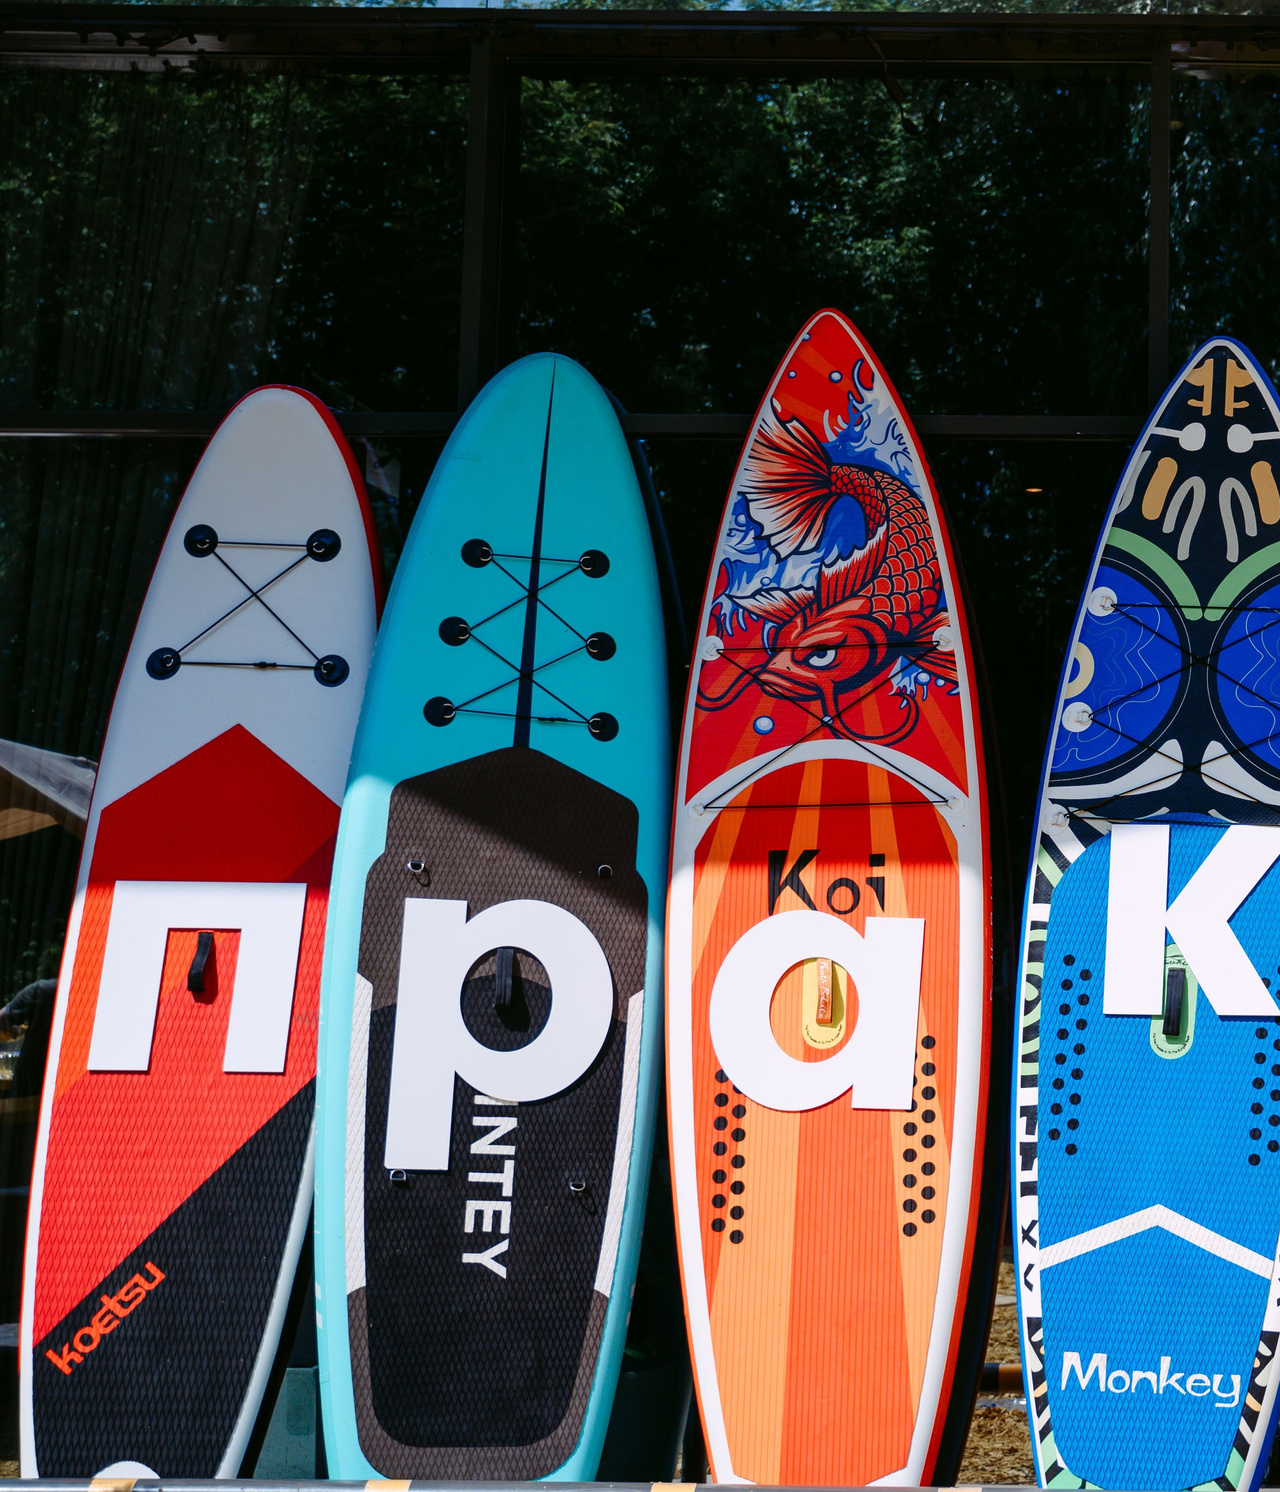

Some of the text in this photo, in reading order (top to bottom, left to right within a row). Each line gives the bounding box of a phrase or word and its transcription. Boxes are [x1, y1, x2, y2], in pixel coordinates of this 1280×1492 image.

[768, 849, 886, 916] Koi
[45, 1261, 166, 1376] koetsu
[1061, 1351, 1241, 1408] Monkey
